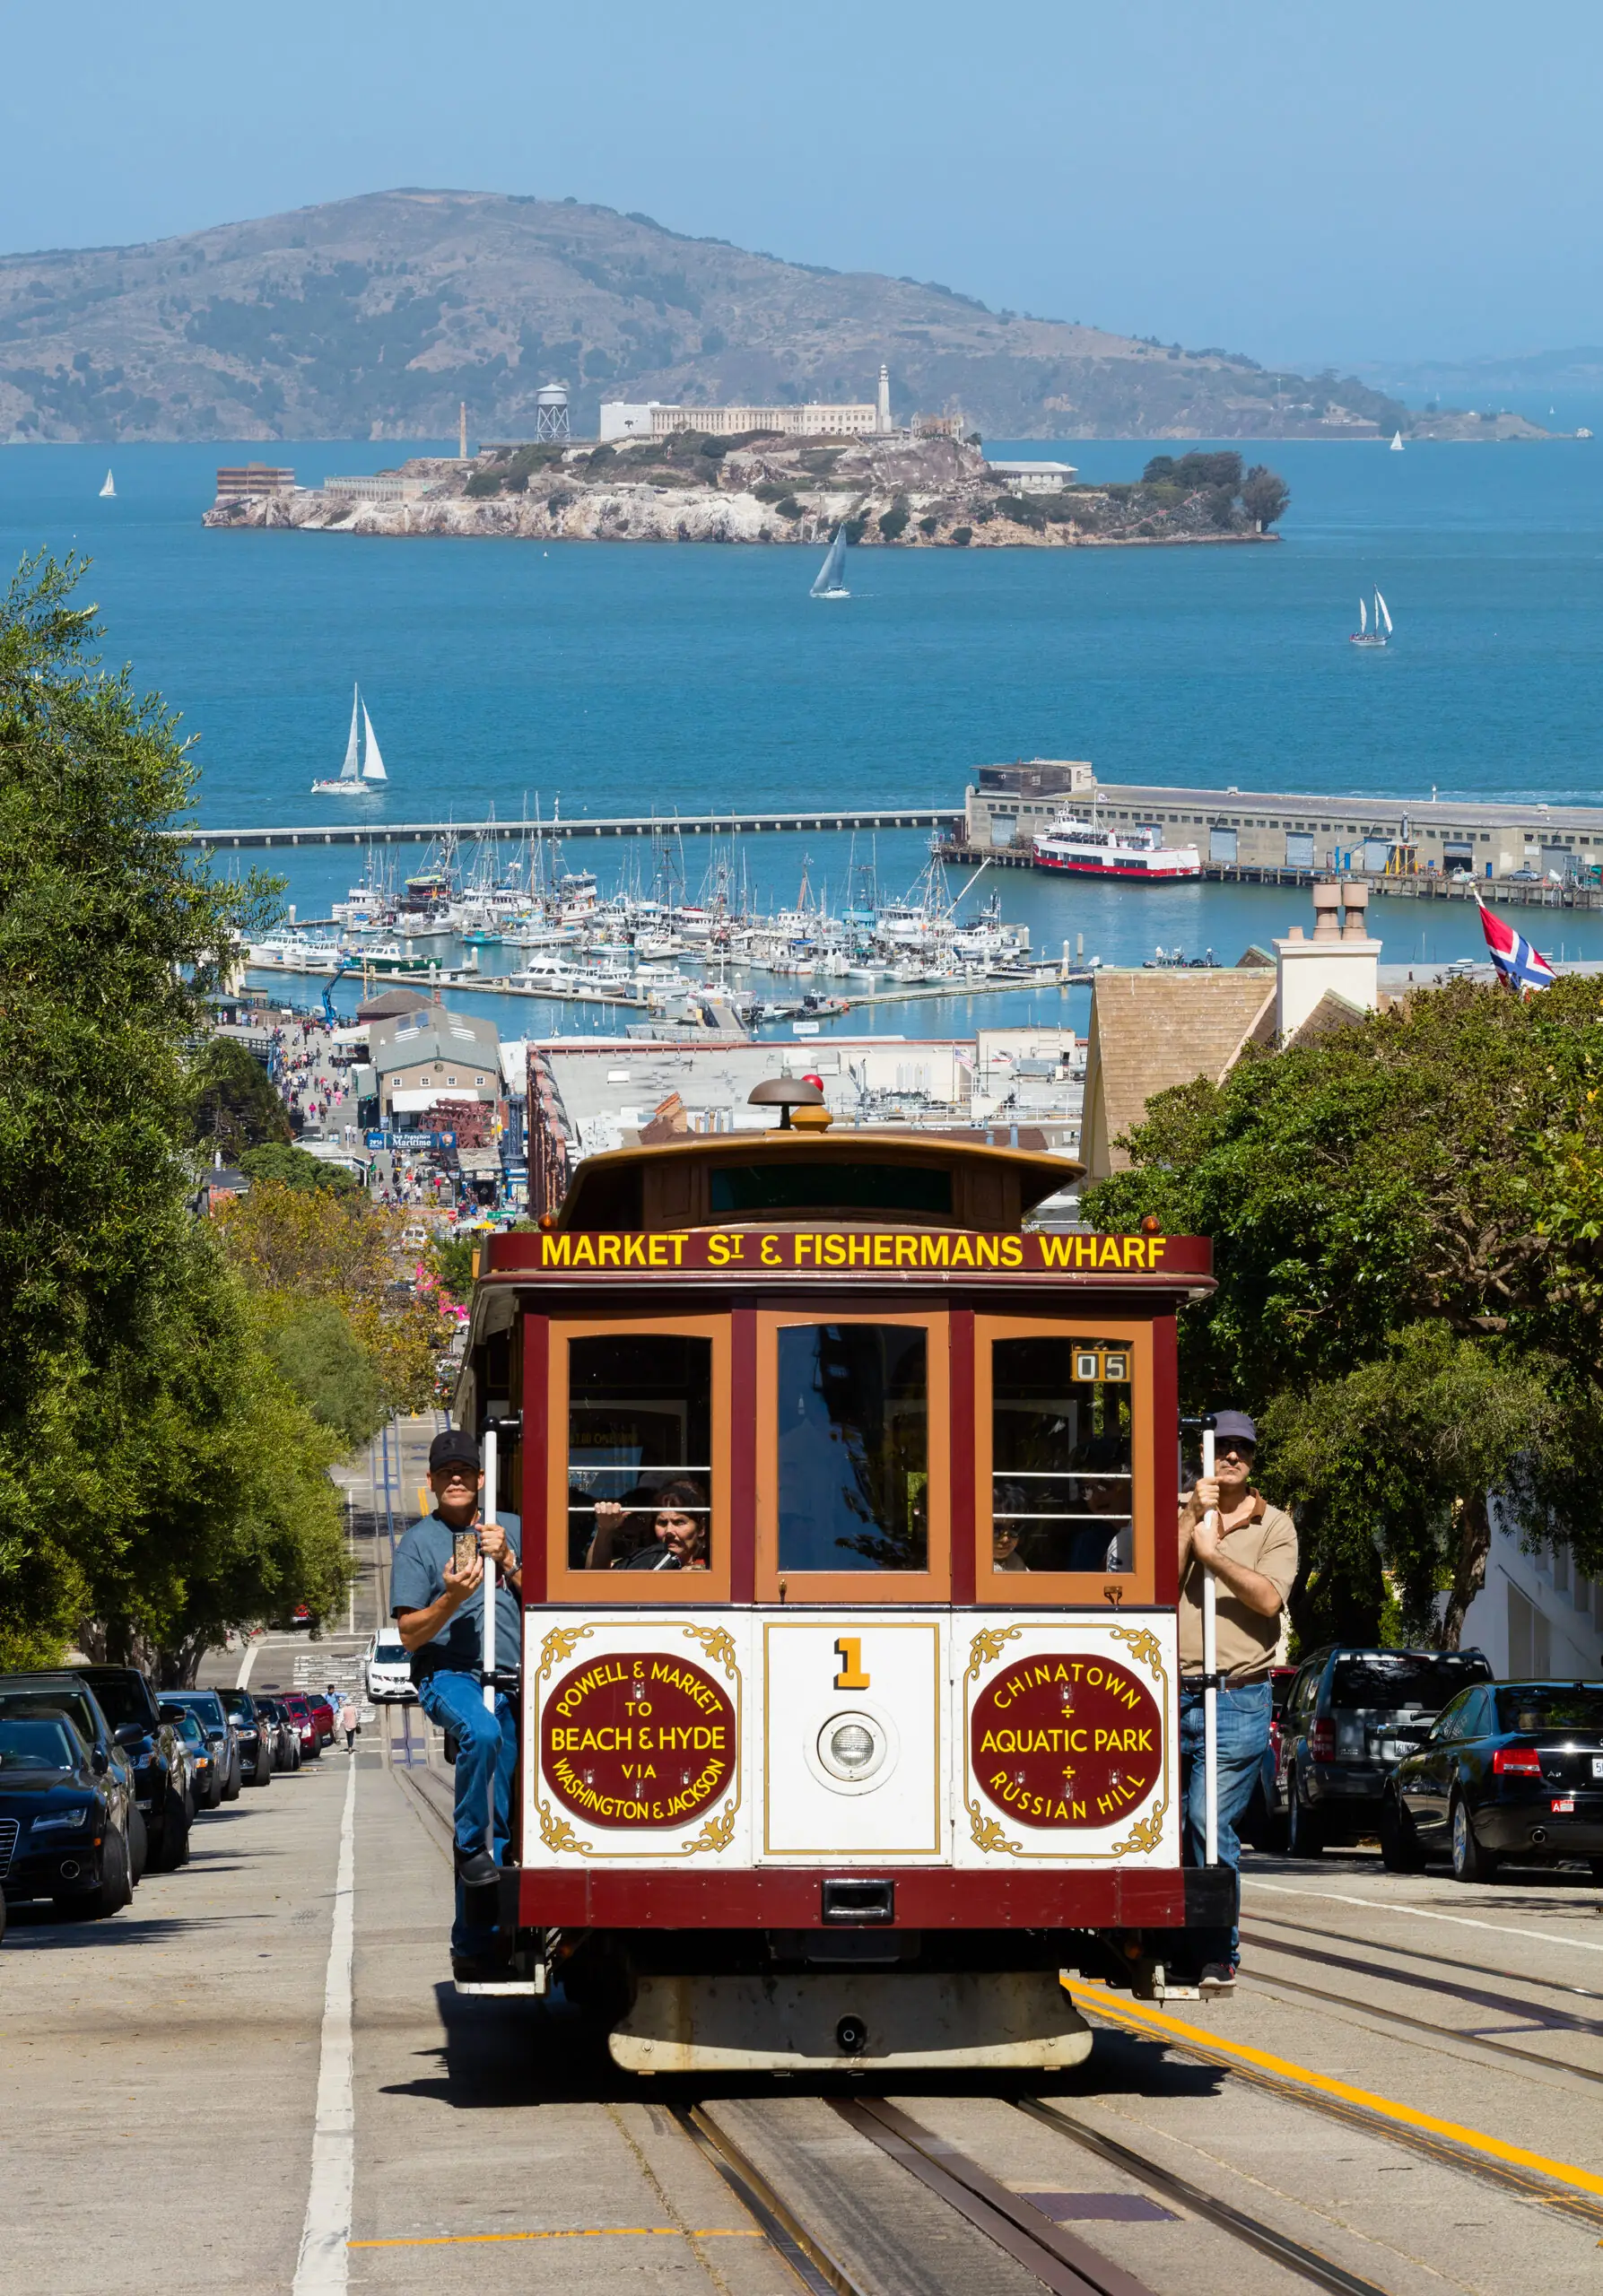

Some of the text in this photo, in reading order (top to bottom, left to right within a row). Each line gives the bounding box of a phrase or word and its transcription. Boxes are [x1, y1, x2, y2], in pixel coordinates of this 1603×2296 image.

[542, 1234, 688, 1266] MARKET
[760, 1234, 783, 1265] &
[794, 1233, 1024, 1267] FISHERMANS
[1038, 1236, 1167, 1268] WHARF
[832, 1637, 871, 1692] 1
[555, 1660, 724, 1718] POWELL & MARKET
[994, 1663, 1142, 1710] CHINATOWN
[624, 1701, 652, 1717] TO
[552, 1726, 726, 1751] BEACH & HYDE
[980, 1728, 1154, 1753] AQUATIC PARK
[552, 1757, 726, 1820] WASHINGTON & JACKSON
[621, 1763, 657, 1779] VIA
[989, 1770, 1146, 1820] RUSSIAN HILL
